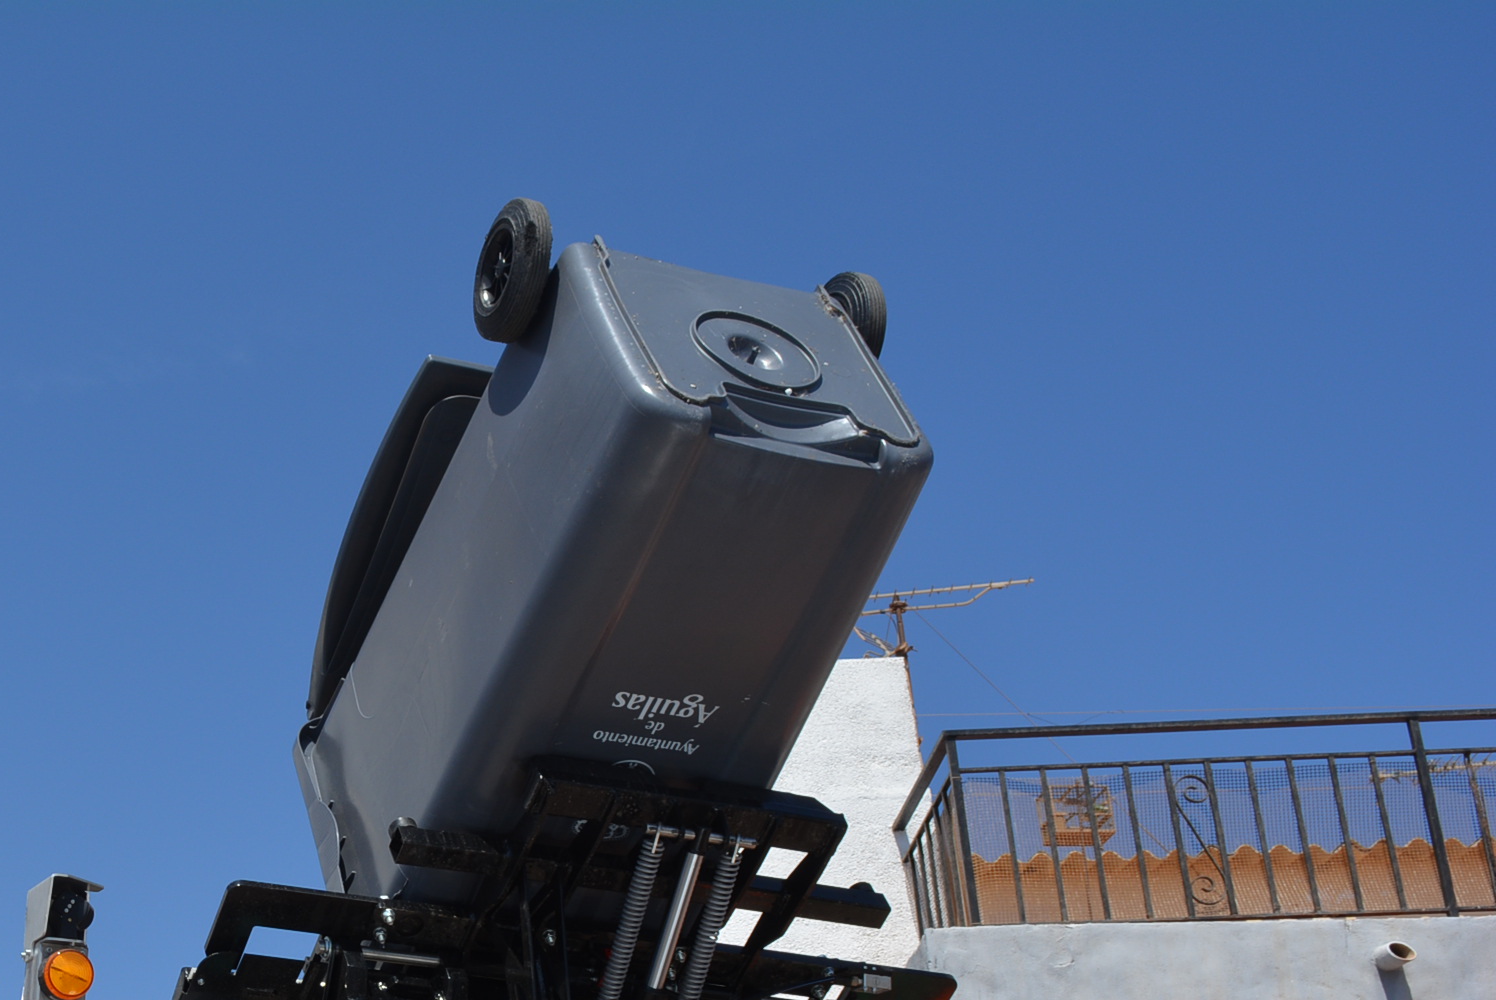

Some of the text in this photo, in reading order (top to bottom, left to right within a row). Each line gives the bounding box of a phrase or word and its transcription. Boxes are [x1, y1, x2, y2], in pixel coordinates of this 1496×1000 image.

[612, 691, 720, 728] Águilas
[645, 720, 665, 734] de
[593, 730, 700, 755] Ayuntamiento
